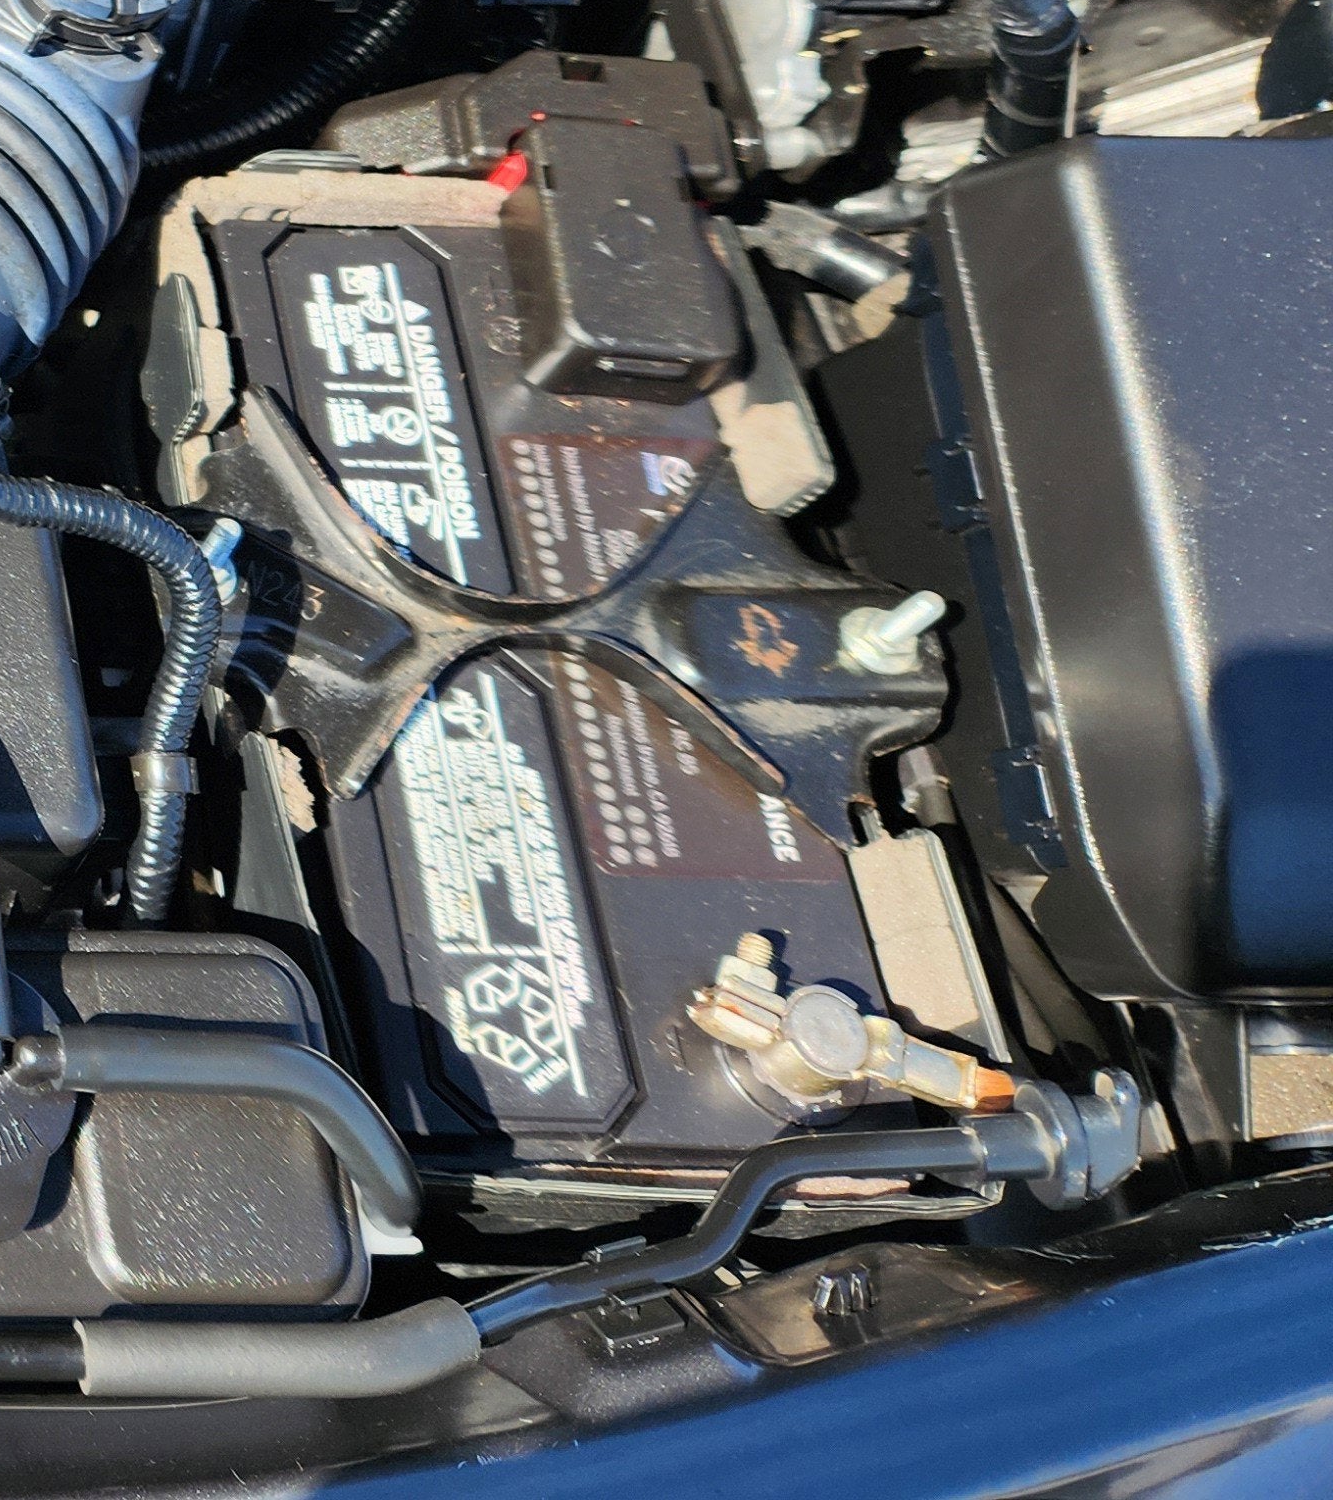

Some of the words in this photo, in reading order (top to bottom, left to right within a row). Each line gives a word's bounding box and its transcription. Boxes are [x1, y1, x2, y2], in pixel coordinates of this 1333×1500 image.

[603, 715, 640, 797] Replacement
[647, 790, 669, 811] CA
[757, 793, 802, 864] ANCE
